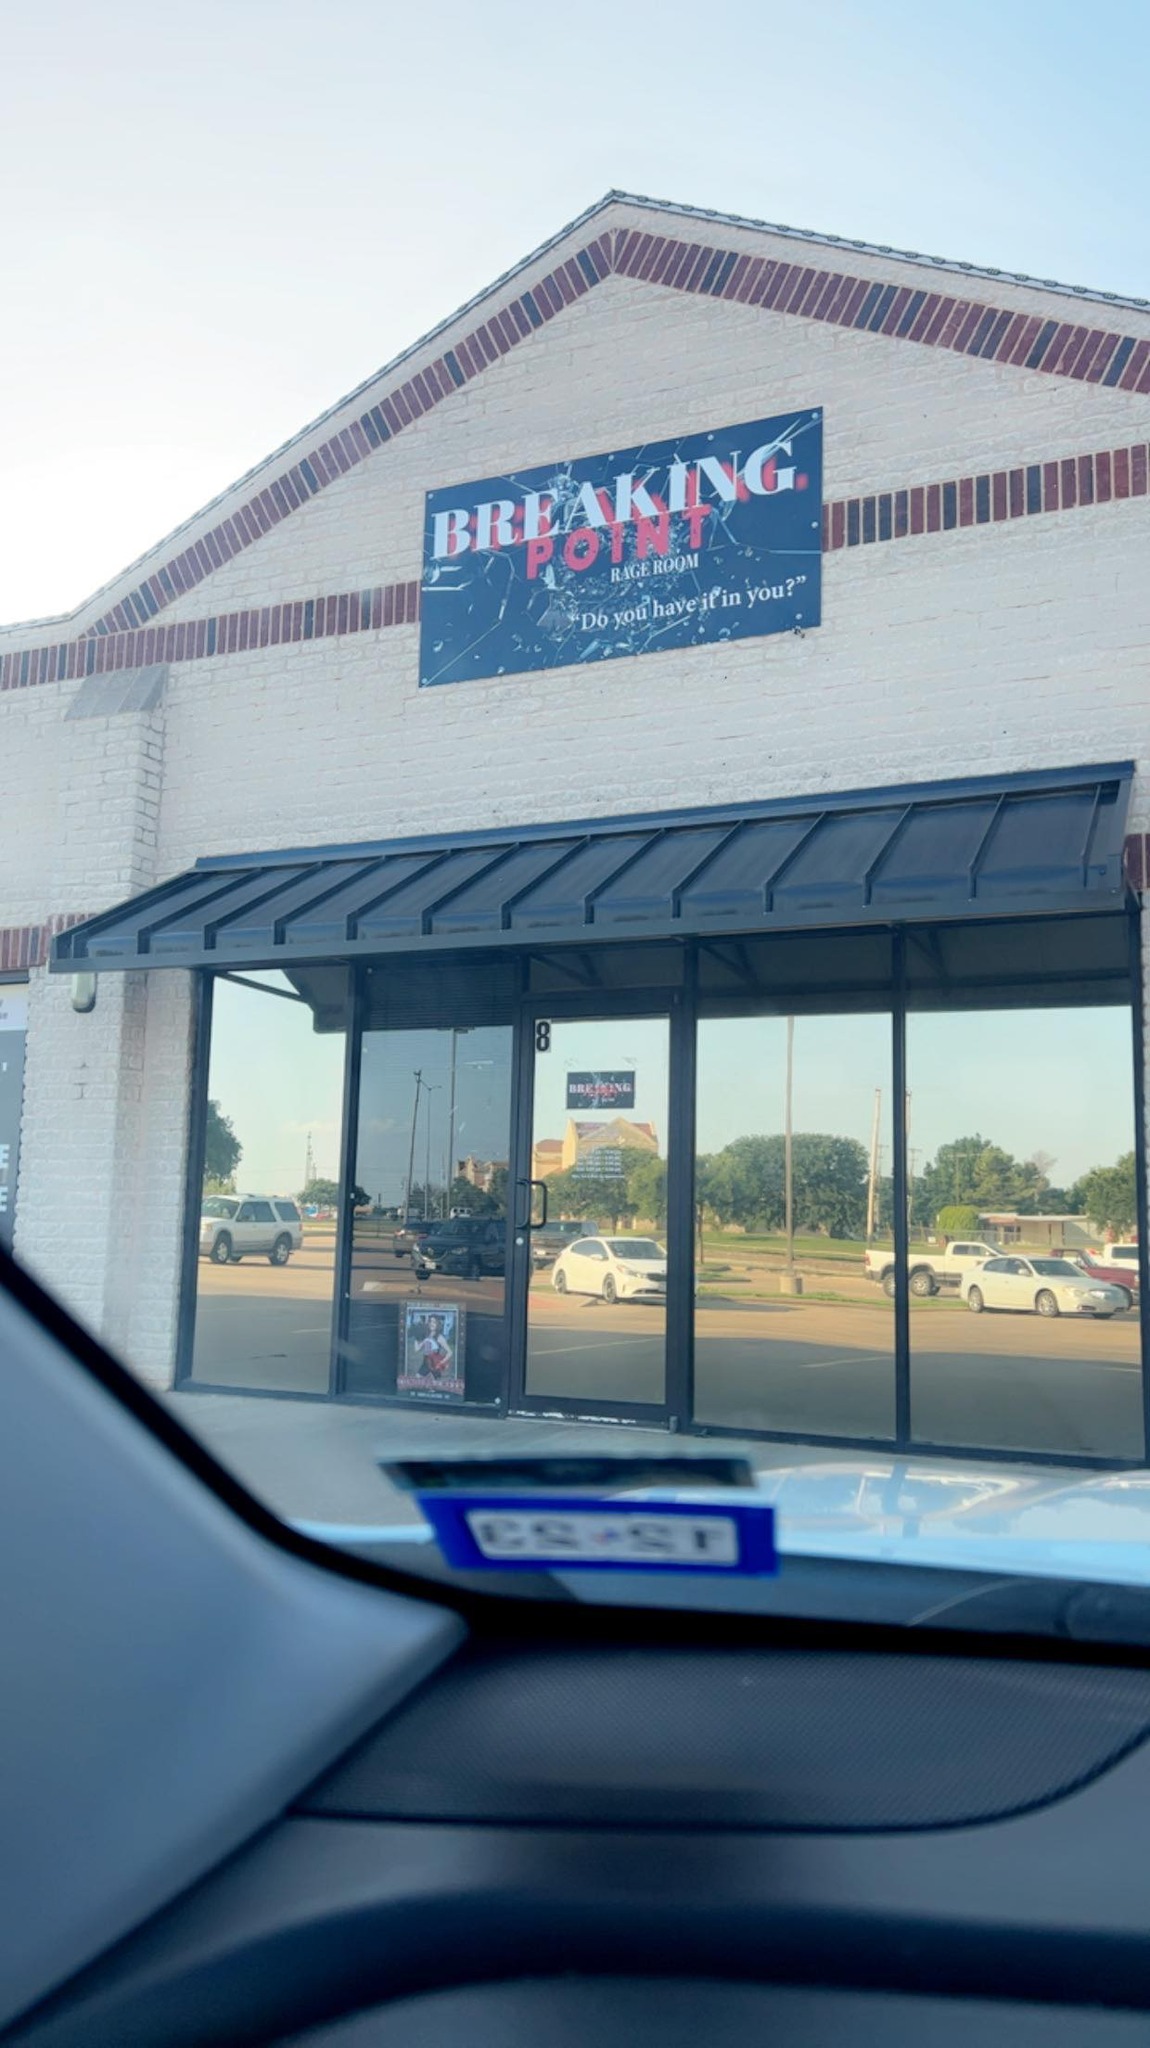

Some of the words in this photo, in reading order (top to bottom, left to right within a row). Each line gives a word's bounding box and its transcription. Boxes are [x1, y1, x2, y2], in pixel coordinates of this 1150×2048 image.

[431, 439, 796, 559] BREAKING
[526, 504, 713, 580] POINT
[610, 561, 650, 583] RAGE
[652, 553, 699, 575] ROOM
[613, 604, 648, 630] you
[652, 598, 697, 621] have
[721, 589, 741, 608] in
[536, 1020, 550, 1051] 8
